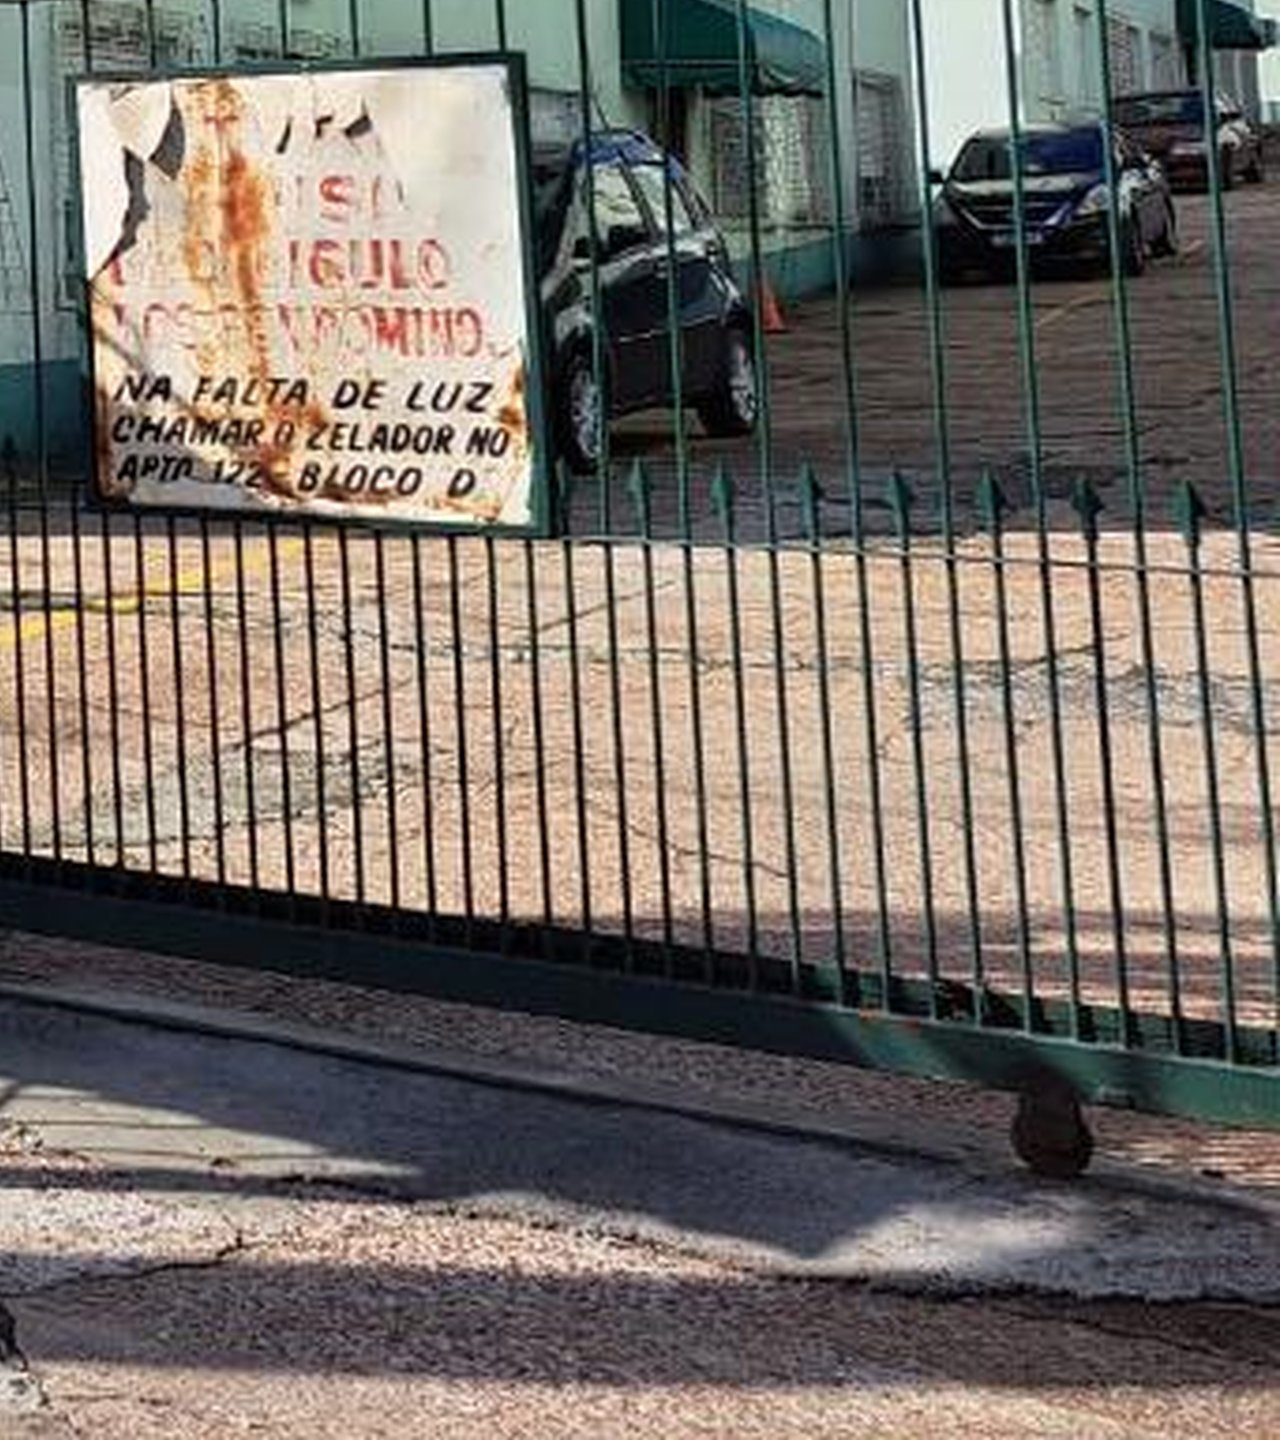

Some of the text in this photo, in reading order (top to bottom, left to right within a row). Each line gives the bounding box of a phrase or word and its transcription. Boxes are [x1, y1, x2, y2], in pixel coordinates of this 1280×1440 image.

[114, 374, 494, 411] NA FALTA DE LUZ
[112, 414, 265, 446] CHAMAR
[306, 422, 456, 454] ZELADOR
[466, 426, 510, 457] NO
[297, 461, 423, 496] BLOCO
[447, 468, 476, 498] D
